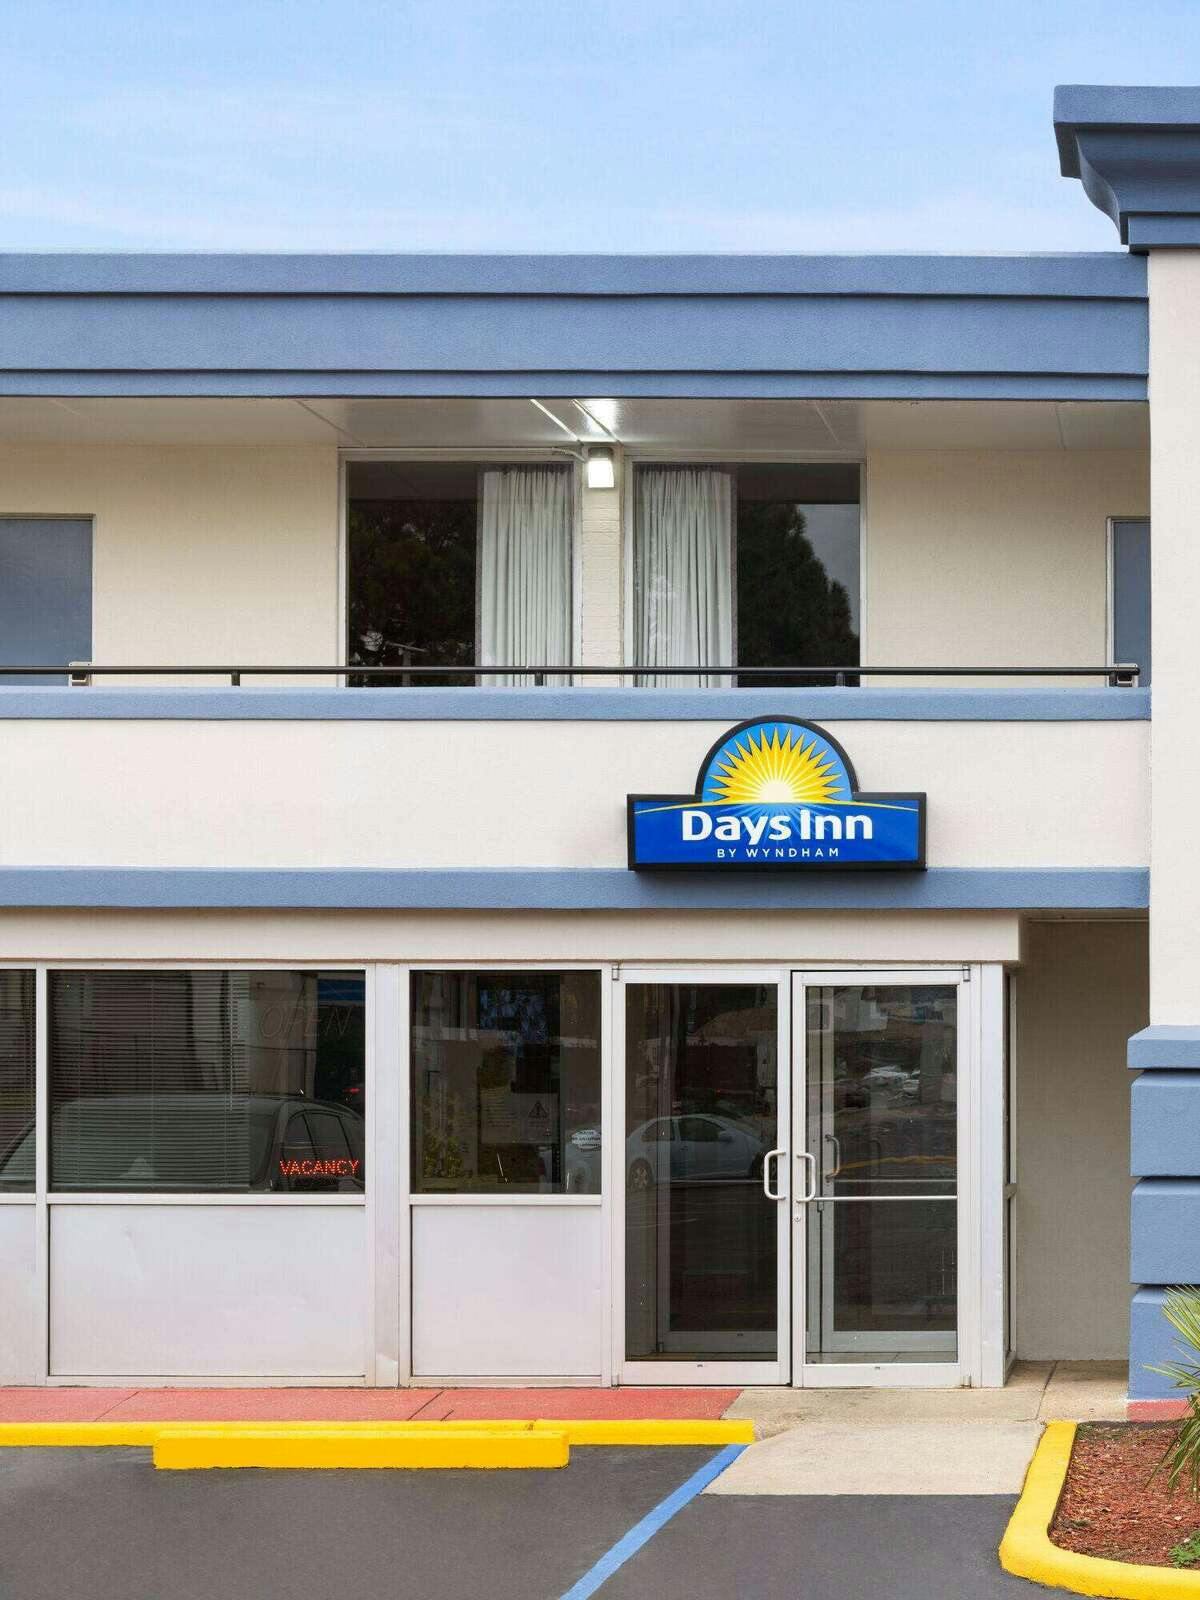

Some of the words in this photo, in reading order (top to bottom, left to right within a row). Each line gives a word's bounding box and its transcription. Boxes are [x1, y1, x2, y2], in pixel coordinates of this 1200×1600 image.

[682, 810, 792, 845] Days
[800, 809, 873, 840] Inn
[716, 848, 737, 858] BY
[746, 847, 839, 858] WYNDHAM
[259, 1005, 353, 1038] OPEN
[280, 1159, 359, 1175] VACANCY
